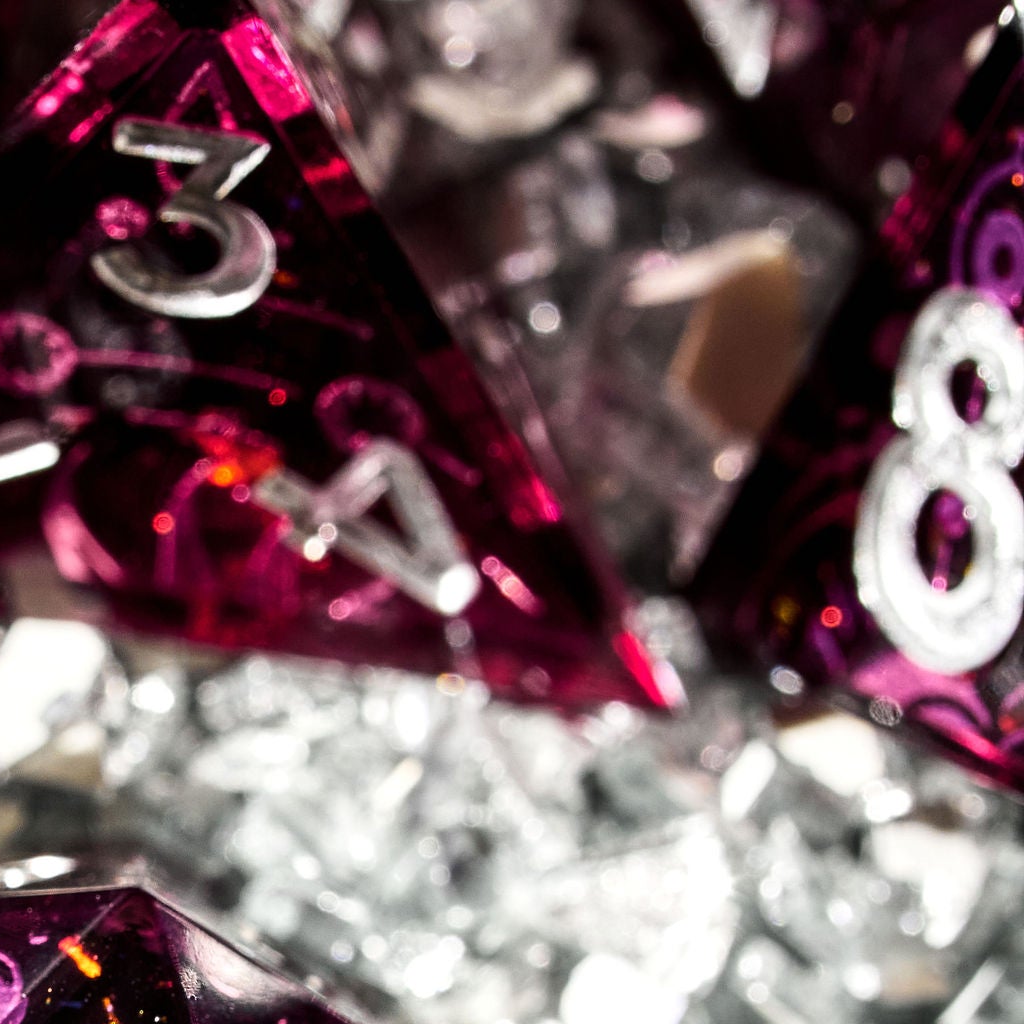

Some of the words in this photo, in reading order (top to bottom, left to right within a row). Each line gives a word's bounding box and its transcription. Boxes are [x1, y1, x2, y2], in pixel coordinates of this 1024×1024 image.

[92, 115, 276, 318] 3
[251, 437, 482, 615] 4
[853, 286, 1024, 674] 8
